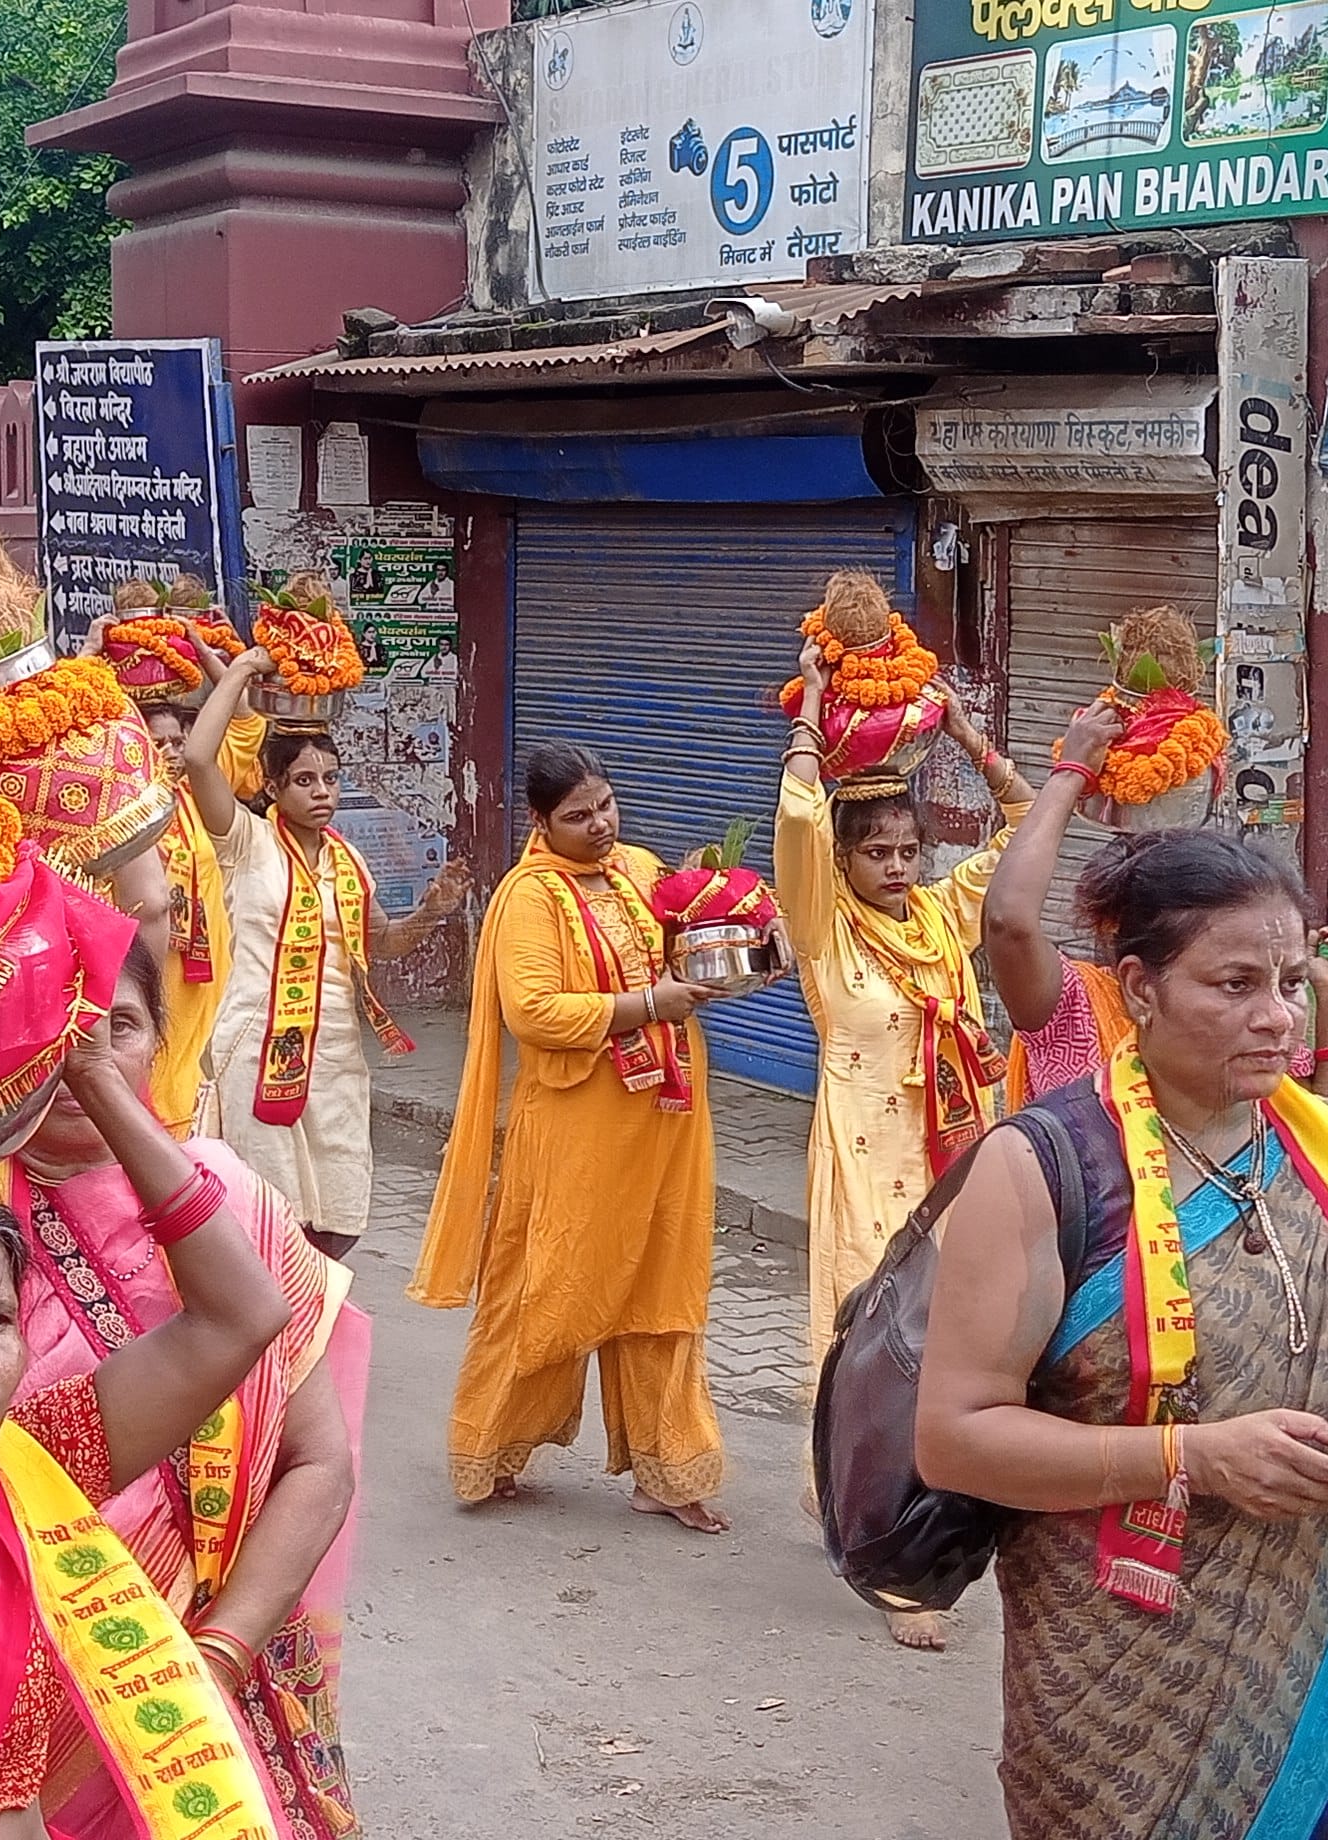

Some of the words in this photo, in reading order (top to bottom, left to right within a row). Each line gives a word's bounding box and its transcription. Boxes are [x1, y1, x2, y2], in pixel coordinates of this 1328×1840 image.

[777, 114, 857, 156] पासपोर्ट
[724, 138, 760, 224] 5
[789, 171, 838, 207] फोटो
[911, 182, 1040, 237] KANIKA
[1052, 172, 1121, 225] PAN
[719, 244, 757, 266] मिनट
[760, 240, 775, 261] में
[787, 226, 841, 258] तैयार
[55, 355, 69, 384] श्री
[70, 362, 107, 385] जयराम
[108, 356, 154, 385] विद्यापीठ
[59, 390, 96, 422] बिरला
[99, 391, 133, 428] मन्दिर
[987, 413, 1060, 449] करियाणा
[1132, 414, 1199, 447] नमकीन
[108, 437, 148, 462] आश्रम
[172, 472, 204, 507] मन्दिर
[66, 512, 88, 533] बाबा
[90, 513, 116, 535] श्रवण
[119, 514, 140, 537] नाथ
[142, 509, 155, 538] की
[157, 509, 185, 544] हवेली
[70, 555, 93, 583] ब्रह्म
[95, 553, 131, 583] सरोवर
[377, 562, 433, 576] तनुजा
[381, 636, 437, 650] तनुजा
[36, 1524, 71, 1545] राधे
[72, 1597, 107, 1620] राधे
[109, 1582, 145, 1605] राधे
[113, 1674, 149, 1699] राधे
[150, 1661, 182, 1685] राधे
[154, 1757, 185, 1783] राधे
[185, 1743, 218, 1769] राधे
